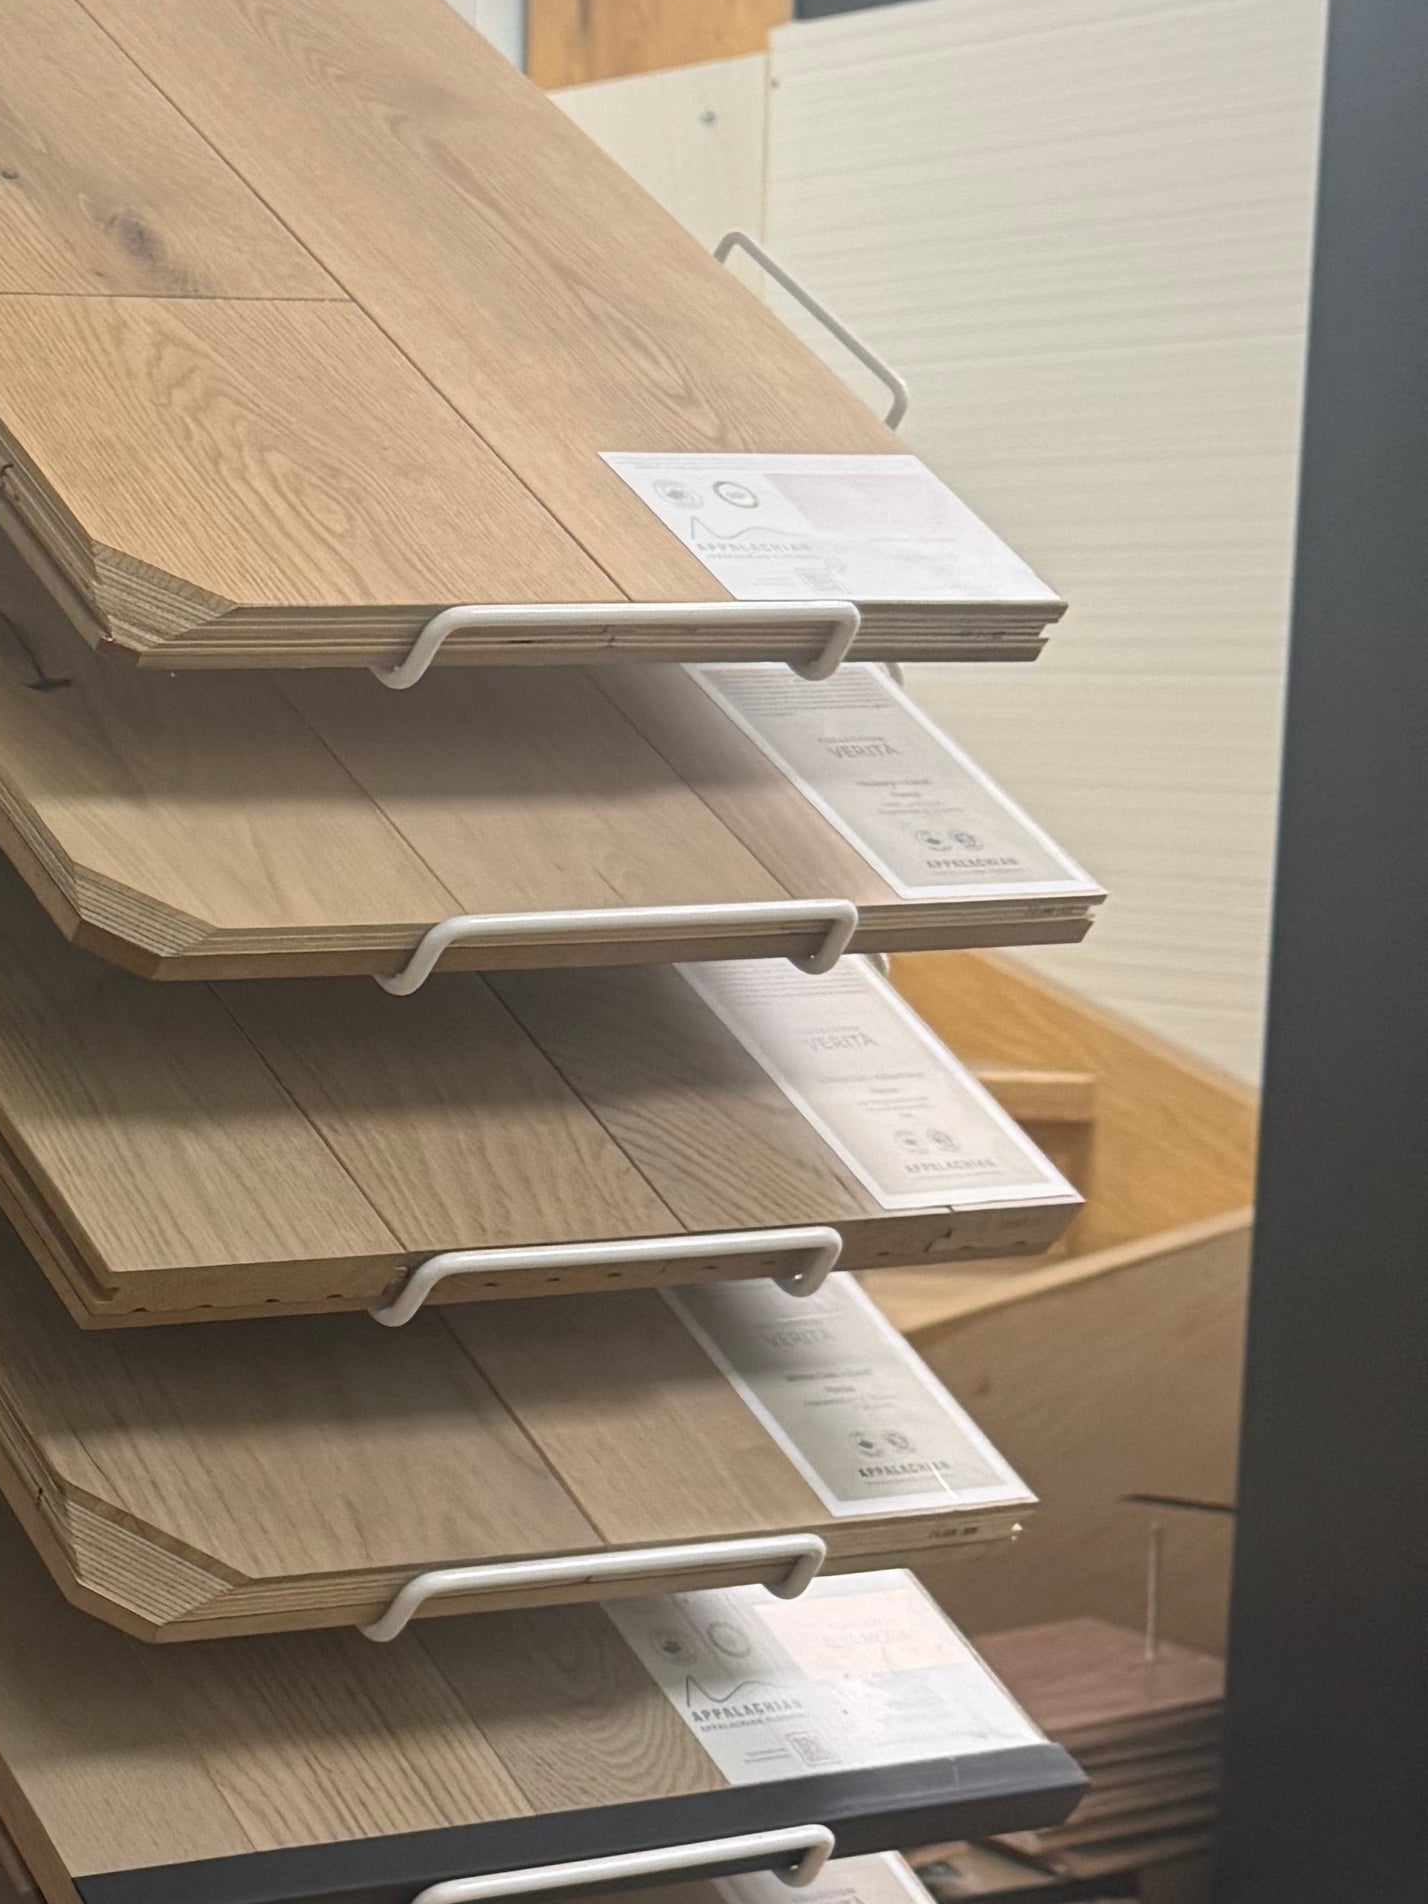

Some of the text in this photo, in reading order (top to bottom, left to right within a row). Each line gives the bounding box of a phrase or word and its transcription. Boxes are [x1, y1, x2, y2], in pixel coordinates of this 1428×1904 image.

[926, 858, 1019, 869] APPALACHIAN
[905, 1159, 996, 1173] APPALACHIAN
[857, 1461, 950, 1479] APPALACHIAN
[692, 1699, 803, 1723] APPALACHIAN
